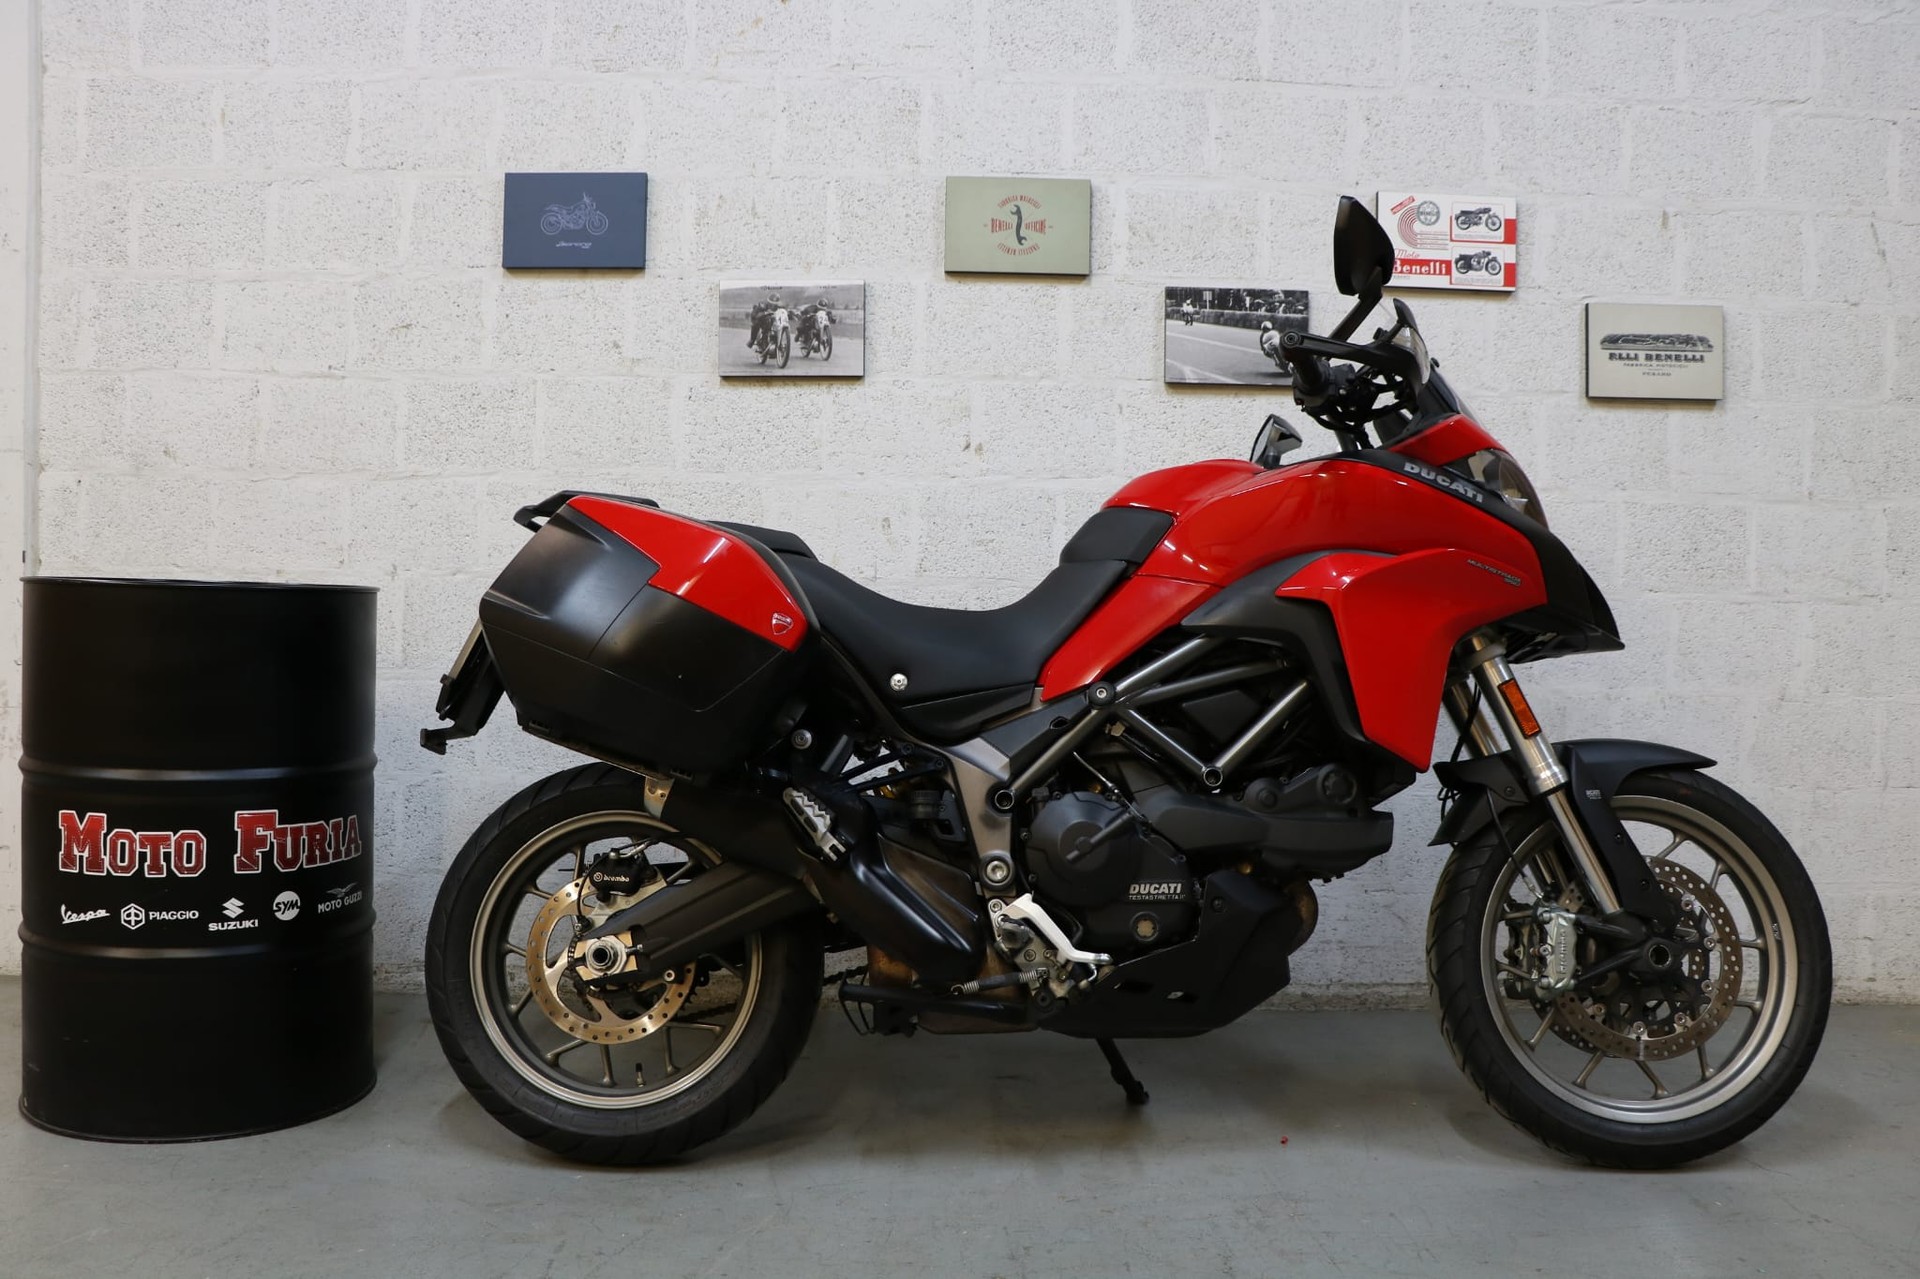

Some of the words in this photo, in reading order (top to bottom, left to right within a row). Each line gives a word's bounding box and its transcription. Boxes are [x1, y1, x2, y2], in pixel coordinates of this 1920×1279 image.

[1393, 259, 1446, 275] Benelli
[1644, 353, 1705, 363] BENELLI
[1403, 462, 1484, 503] DUCATI
[603, 874, 629, 882] brembo
[1129, 883, 1182, 894] DUCATI
[273, 898, 300, 916] SYM
[317, 899, 342, 914] MOTO
[344, 890, 363, 906] GUZZI
[60, 904, 111, 925] Vespa
[148, 910, 199, 921] PIAGGIO
[208, 918, 259, 931] SUZUKI
